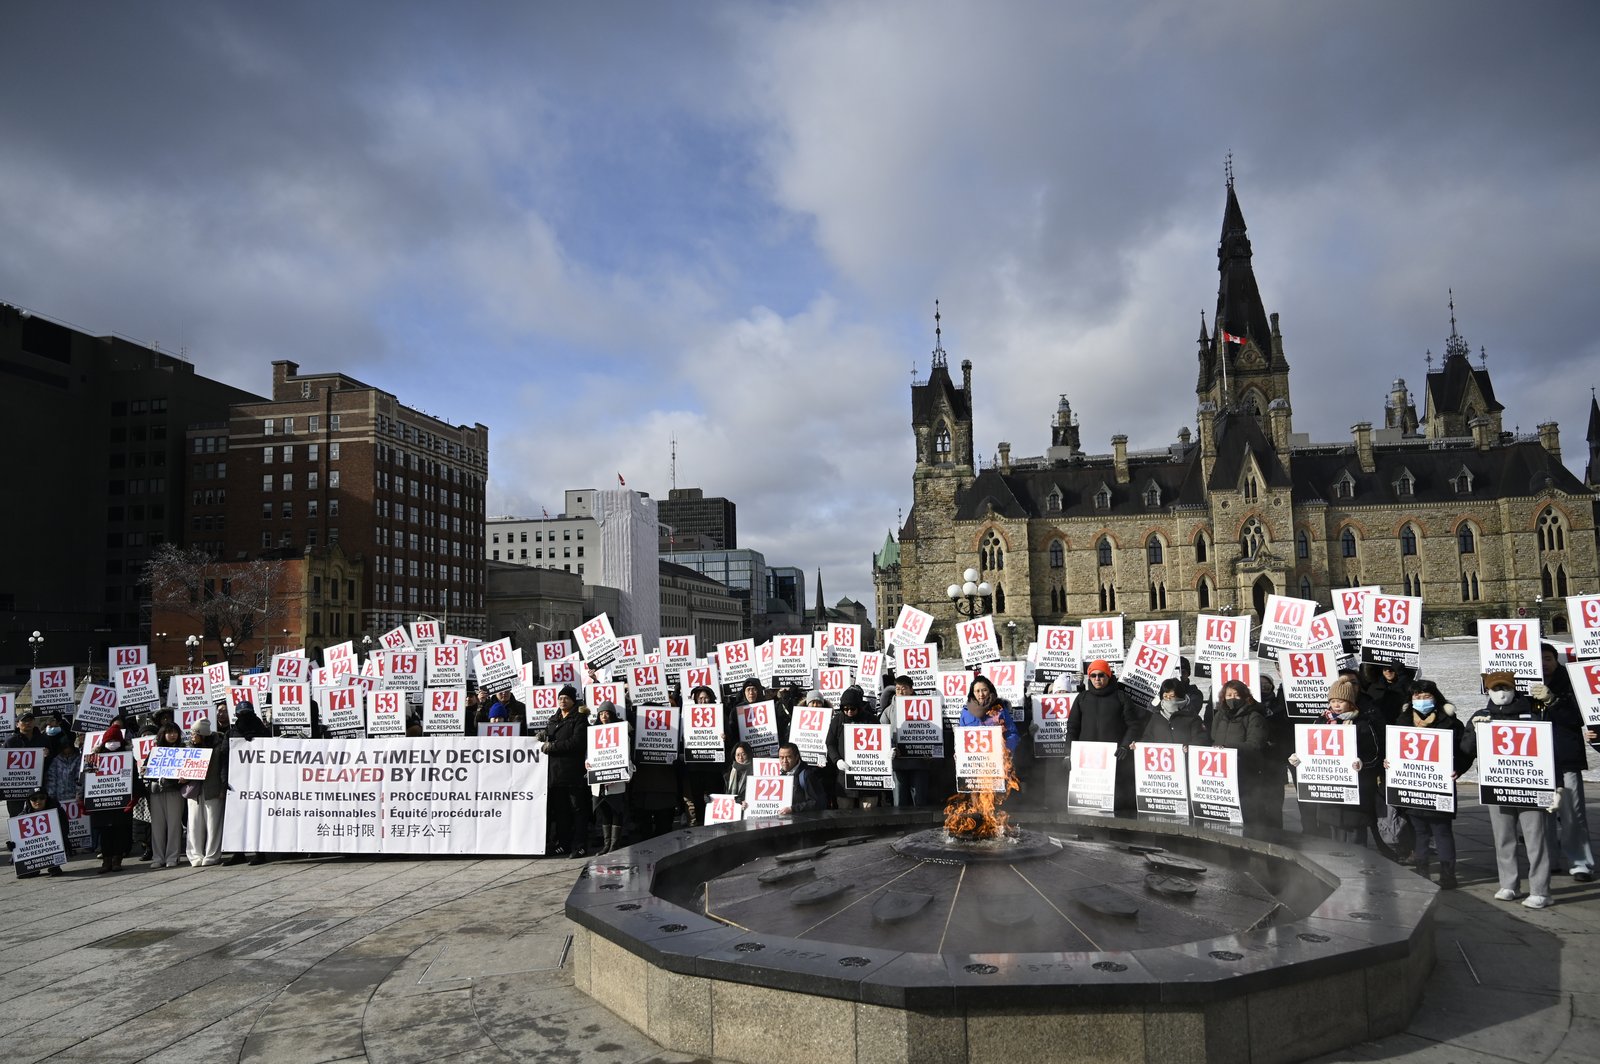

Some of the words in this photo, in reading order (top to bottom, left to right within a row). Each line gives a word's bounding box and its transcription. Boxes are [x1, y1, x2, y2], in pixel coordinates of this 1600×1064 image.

[1279, 602, 1301, 624] 70
[1378, 600, 1406, 624] 36
[419, 624, 433, 638] 31
[584, 620, 604, 642] 33
[905, 612, 922, 634] 43
[1092, 622, 1110, 640] 11
[1211, 620, 1232, 642] 16
[1377, 626, 1404, 634] MONTHS
[387, 632, 403, 648] 25
[836, 628, 852, 646] 38
[966, 622, 987, 644] 29
[1050, 630, 1070, 649] 63
[1146, 625, 1168, 645] 27
[1495, 624, 1522, 650] 37
[330, 645, 347, 660] 27
[547, 643, 563, 660] 39
[669, 640, 687, 656] 27
[728, 644, 746, 663] 33
[783, 638, 801, 655] 34
[1381, 641, 1415, 649] RESPONSE
[120, 649, 137, 665] 19
[438, 648, 455, 665] 53
[483, 644, 504, 665] 68
[906, 649, 926, 669] 65
[1139, 647, 1164, 674] 35
[280, 660, 299, 677] 42
[334, 660, 351, 678] 22
[395, 656, 414, 673] 15
[555, 664, 571, 682] 55
[863, 656, 876, 675] 55
[1294, 654, 1322, 676] 31
[43, 672, 64, 688] 54
[126, 669, 146, 687] 42
[210, 666, 223, 683] 39
[636, 667, 656, 686] 34
[690, 669, 707, 688] 27
[822, 671, 841, 689] 30
[994, 666, 1013, 686] 72
[1226, 664, 1248, 686] 11
[185, 678, 202, 695] 32
[946, 676, 966, 695] 62
[92, 688, 116, 707] 20
[234, 688, 252, 705] 31
[282, 686, 299, 704] 11
[333, 690, 354, 710] 71
[377, 693, 395, 713] 53
[435, 692, 455, 711] 34
[535, 690, 555, 708] 68
[596, 687, 614, 705] 39
[695, 708, 713, 727] 33
[747, 706, 766, 727] 46
[907, 700, 931, 720] 40
[1045, 699, 1068, 719] 23
[648, 711, 667, 729] 81
[802, 711, 820, 730] 24
[598, 728, 616, 748] 41
[857, 729, 879, 750] 34
[967, 731, 990, 752] 35
[1313, 730, 1340, 756] 14
[1404, 733, 1435, 761] 37
[1498, 726, 1531, 756] 37
[10, 752, 34, 769] 20
[156, 748, 179, 758] STOP
[182, 748, 202, 758] THE
[238, 750, 266, 764] WE
[270, 750, 351, 764] DEMAND
[355, 750, 368, 764] A
[373, 750, 441, 764] TIMELY
[446, 749, 540, 764] DECISION
[1148, 748, 1172, 771] 36
[99, 756, 120, 775] 40
[1202, 752, 1224, 776] 21
[1403, 763, 1435, 772] MONTHS
[1490, 767, 1524, 776] WAITING
[1498, 759, 1533, 767] MONTHS
[302, 768, 384, 782] DELAYED
[391, 768, 416, 782] BY
[421, 767, 468, 782] IRCC
[1202, 779, 1224, 787] MONTHS
[1317, 774, 1352, 782] RESPONSE
[1391, 778, 1407, 786] IRCC
[1408, 780, 1448, 789] RESPONSE
[1396, 770, 1426, 779] WAITING
[1505, 777, 1549, 785] RESPONSE
[240, 791, 312, 801] REASONABLE
[314, 792, 376, 801] TIMELINES
[390, 792, 471, 801] PROCEDURAL
[475, 792, 534, 801] FAIRNESS
[759, 780, 780, 800] 22
[1206, 795, 1235, 803] RESPONSE
[268, 808, 302, 817] Délais
[304, 808, 376, 818] raisonnables
[390, 806, 427, 820] Équité
[431, 808, 502, 820] procédurale
[716, 799, 731, 819] 43
[22, 816, 49, 838] 36
[317, 823, 375, 838] 给出时限
[391, 824, 452, 838] 程序公平
[20, 843, 44, 852] WAITING
[25, 836, 49, 845] MONTHS
[31, 845, 60, 856] RESPONSE
